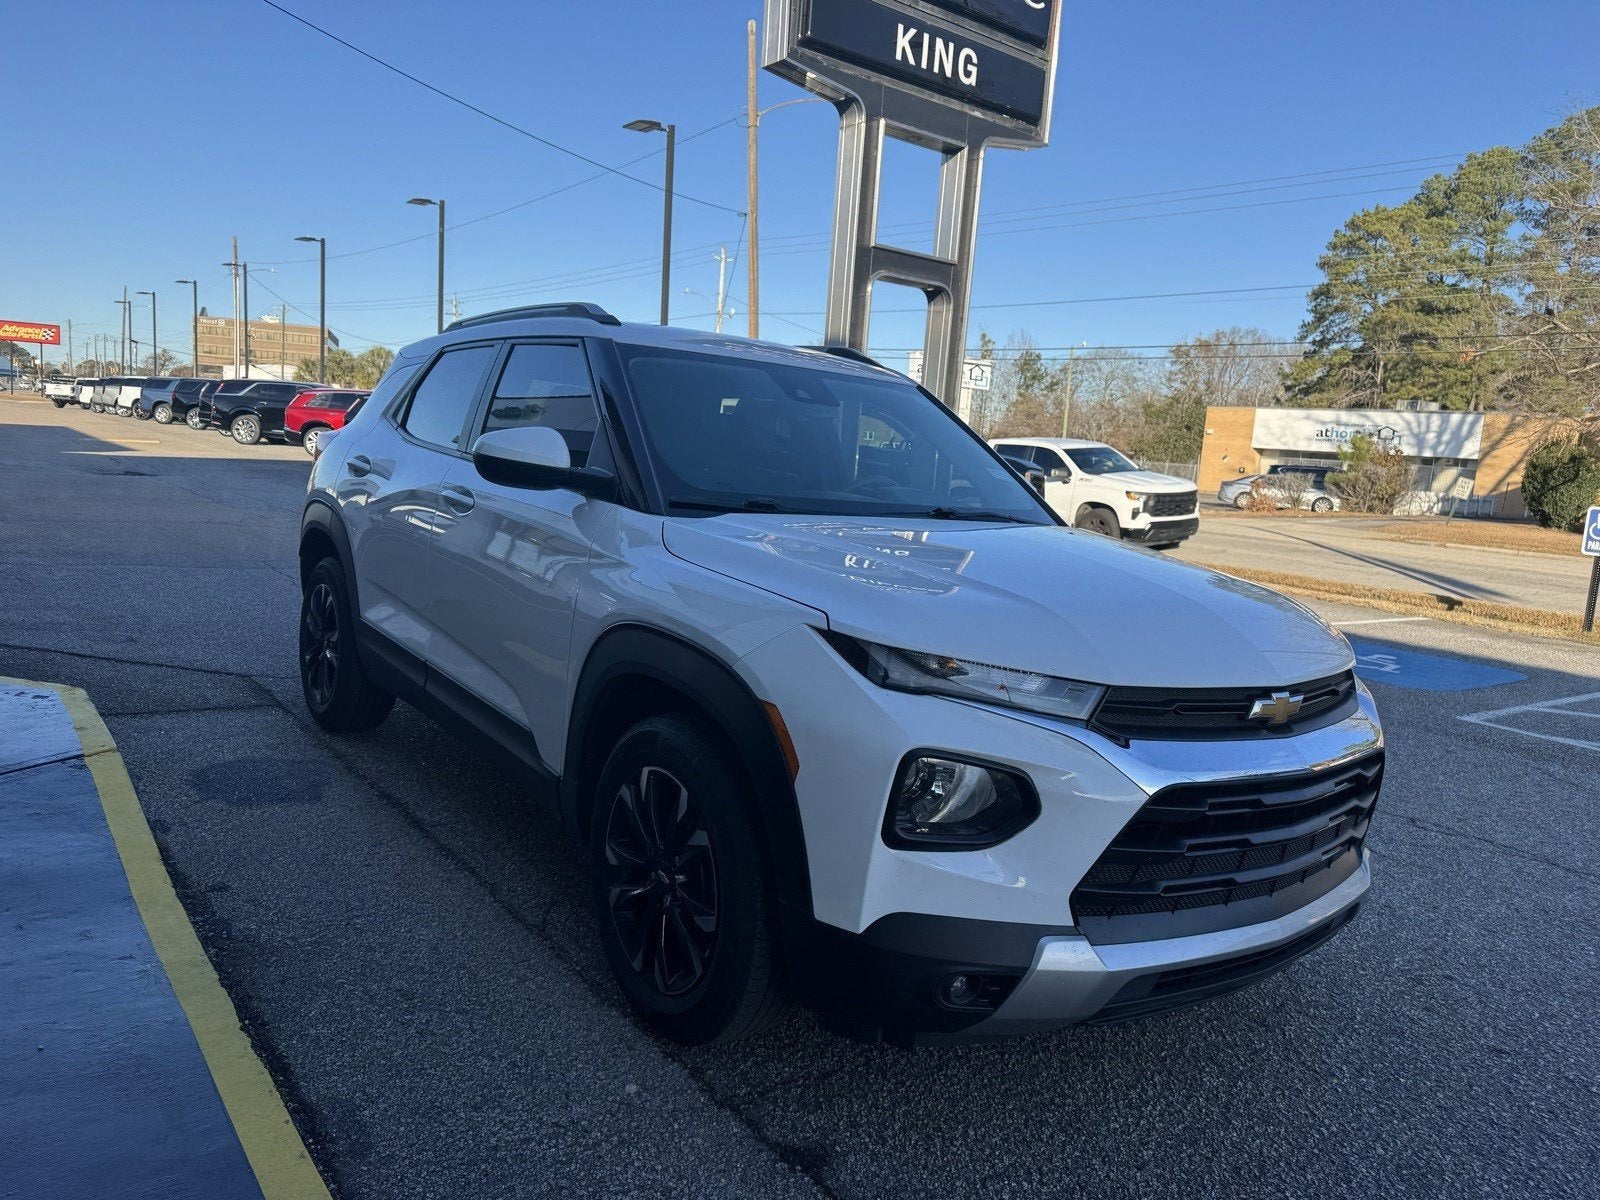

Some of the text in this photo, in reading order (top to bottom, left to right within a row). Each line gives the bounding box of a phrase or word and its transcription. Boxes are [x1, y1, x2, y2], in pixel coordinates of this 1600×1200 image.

[895, 23, 978, 87] KING
[2, 324, 41, 334] Advance
[18, 331, 41, 339] Parts
[1587, 540, 1600, 550] PAR
